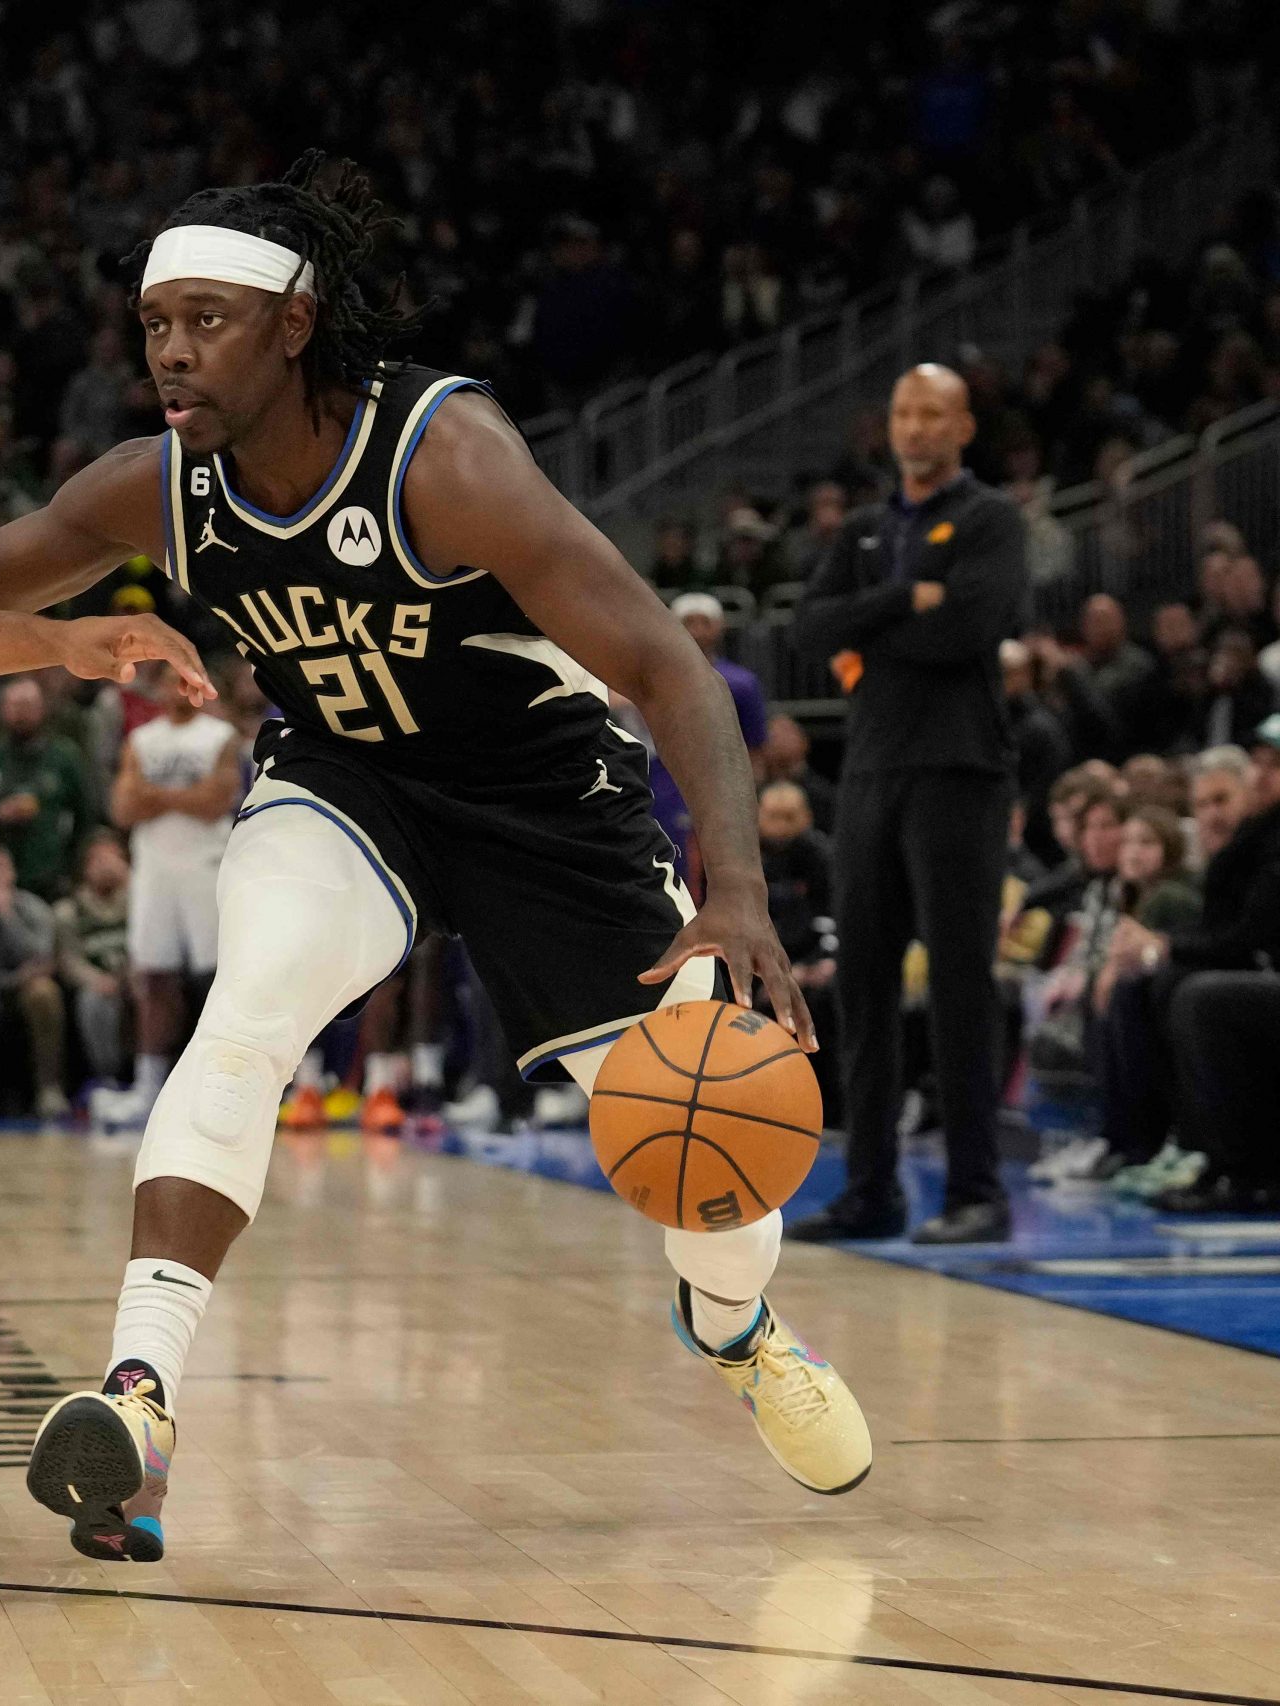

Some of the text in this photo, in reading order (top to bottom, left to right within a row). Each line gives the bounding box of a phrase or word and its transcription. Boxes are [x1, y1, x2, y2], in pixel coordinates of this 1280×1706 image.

[191, 467, 210, 496] 6
[212, 585, 431, 658] UCKS
[298, 651, 421, 742] 21
